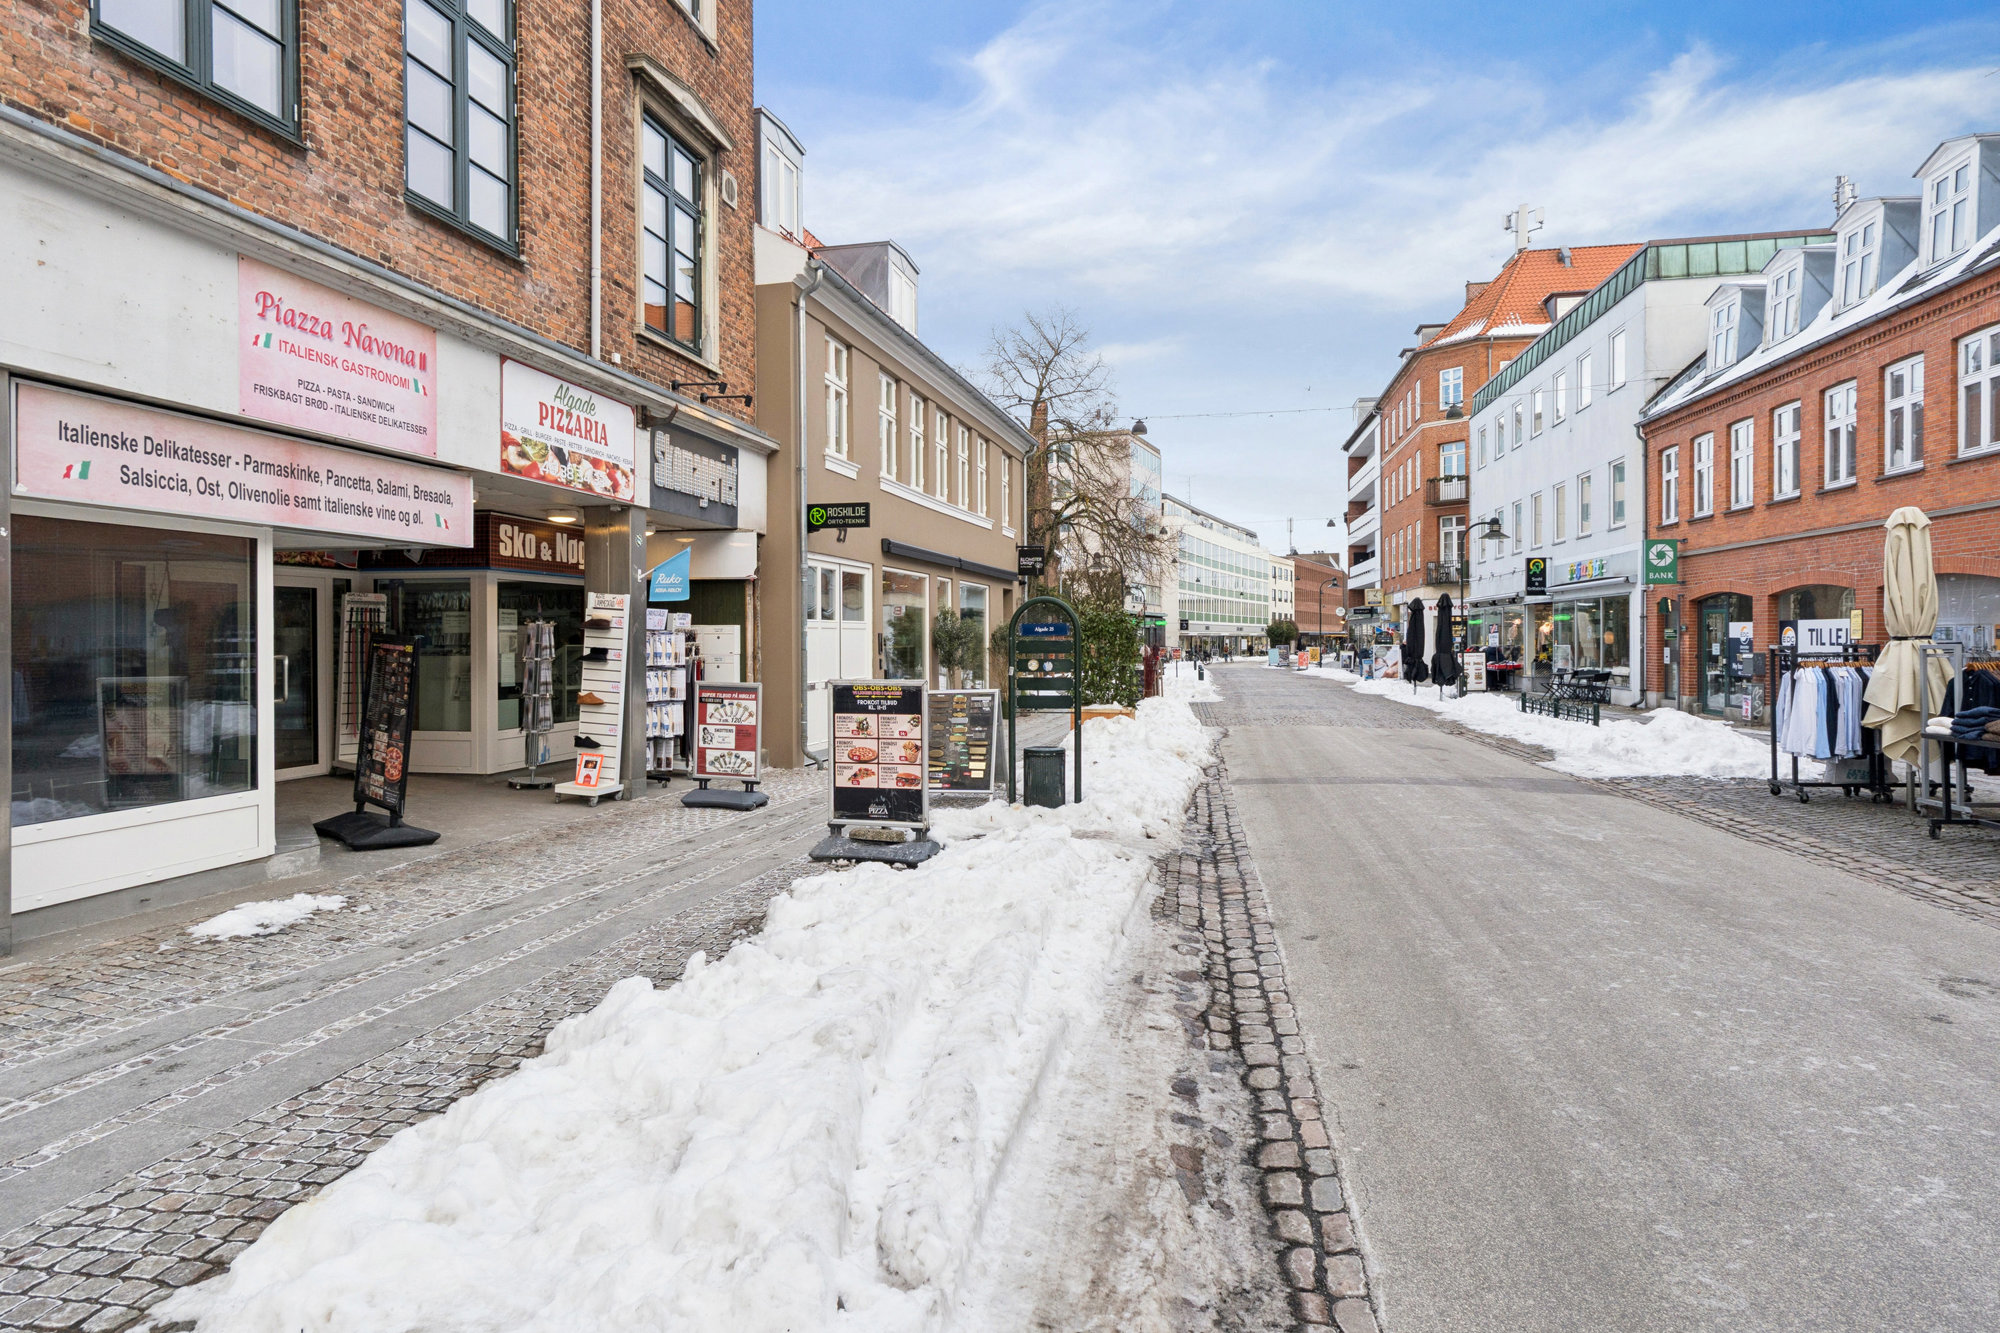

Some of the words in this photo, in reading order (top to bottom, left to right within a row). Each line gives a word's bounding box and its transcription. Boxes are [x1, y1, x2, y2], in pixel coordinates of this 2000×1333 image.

[255, 291, 333, 340] Piazza
[342, 320, 416, 367] Navona
[279, 339, 338, 369] ITALIENSK
[341, 360, 410, 390] GASTRONOMI
[253, 383, 303, 404] FRISKBAGT
[305, 395, 329, 411] BRØD
[334, 404, 377, 424] ITALIENSKE
[378, 412, 428, 436] DELIKATESSER
[297, 378, 321, 394] PIZZA
[327, 387, 351, 402] PASTA
[357, 395, 395, 413] SANDWICH
[553, 383, 597, 417] Algade
[538, 401, 609, 447] PIZZARIA
[58, 420, 139, 453] Italienske
[143, 435, 232, 469] Delikatesser
[243, 454, 323, 487] Parmaskinke,
[326, 469, 374, 495] Pancetta,
[376, 478, 411, 502] Salami,
[413, 484, 454, 508] Bresaola,
[120, 464, 192, 496] Salsiccia,
[196, 476, 224, 500] Ost,
[228, 481, 291, 507] Olivenolie
[293, 495, 322, 511] samt
[324, 495, 374, 518] italienske
[376, 504, 396, 521] vine
[398, 511, 410, 526] og
[412, 509, 424, 525] øl.
[827, 506, 866, 517] ROSKILDE
[499, 524, 536, 559] Sko
[540, 541, 553, 561] &
[655, 573, 684, 584] Ruko
[1782, 635, 1795, 643] EDC
[1807, 628, 1826, 646] TIL
[1829, 628, 1854, 647] LEJ
[868, 807, 888, 815] PIZZA
